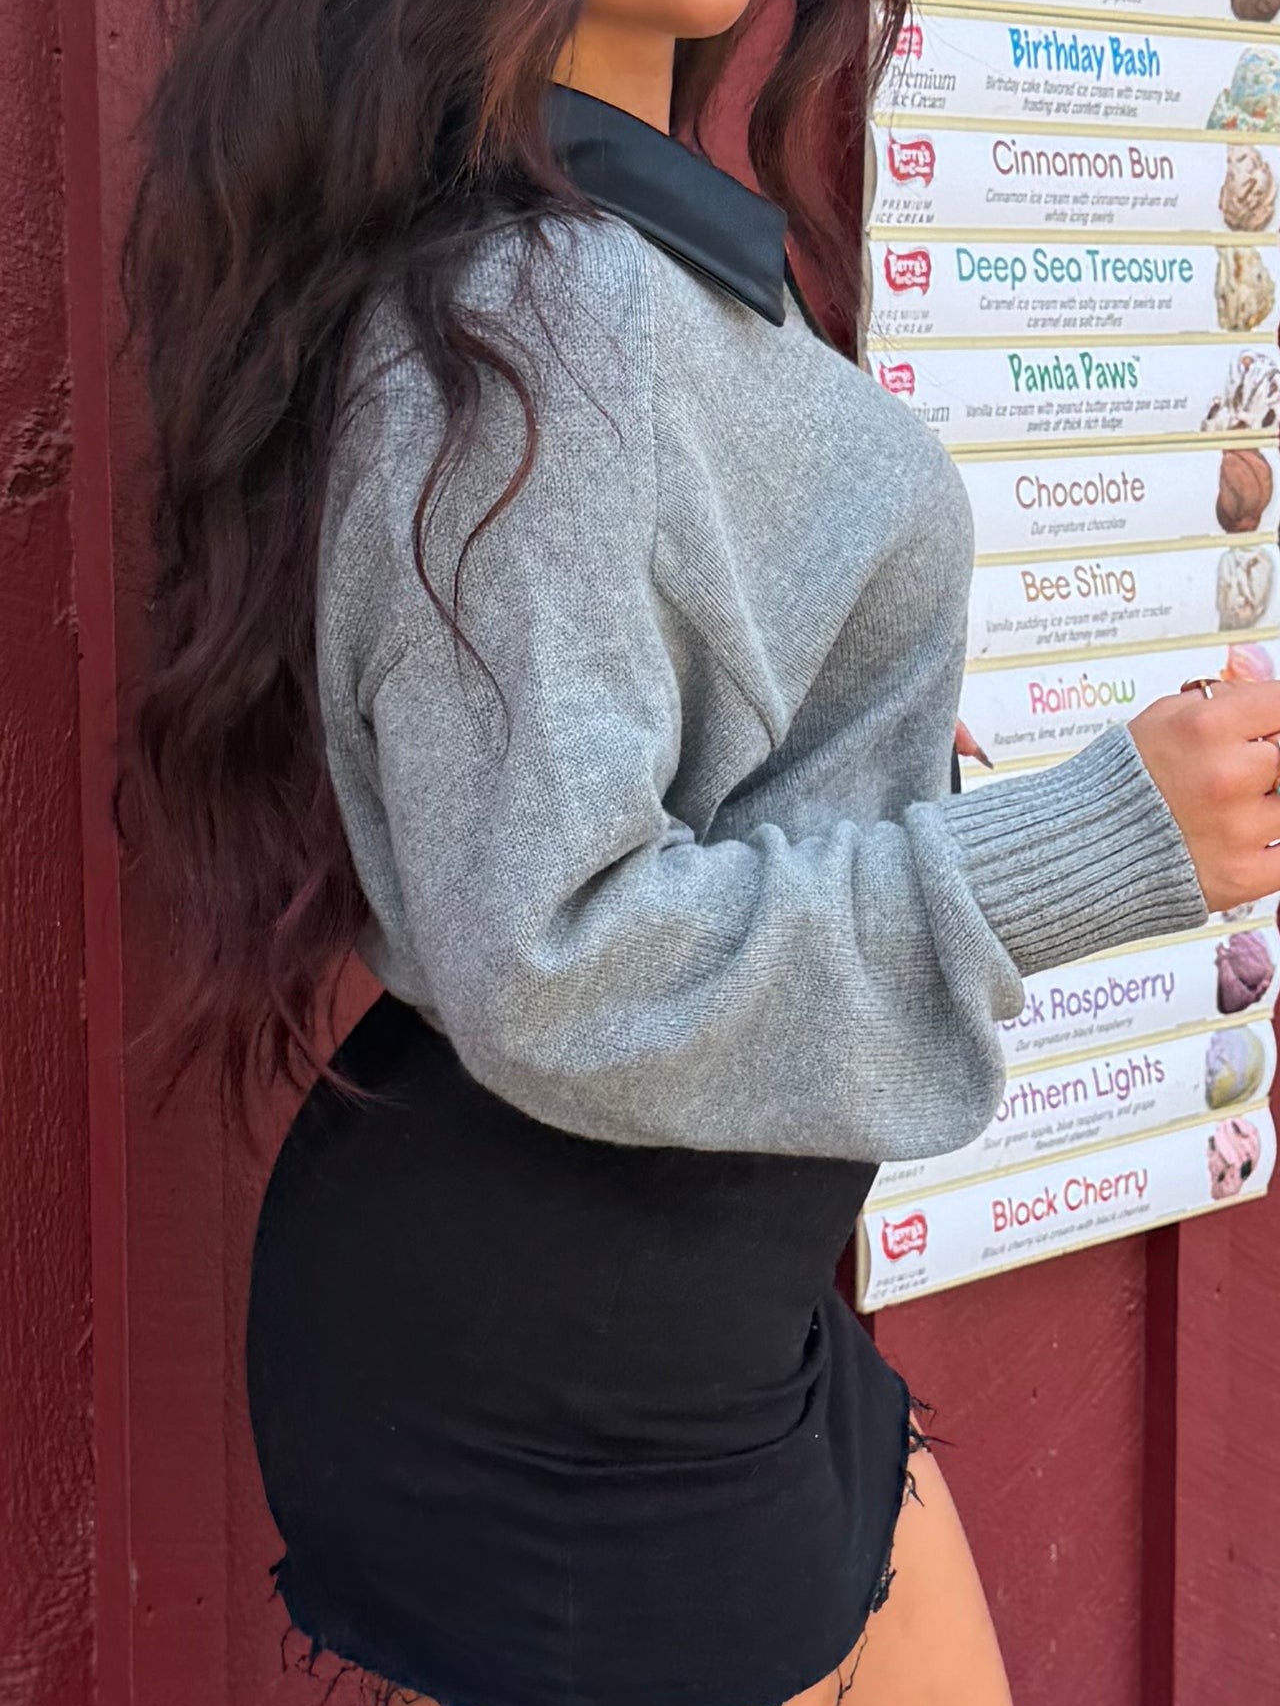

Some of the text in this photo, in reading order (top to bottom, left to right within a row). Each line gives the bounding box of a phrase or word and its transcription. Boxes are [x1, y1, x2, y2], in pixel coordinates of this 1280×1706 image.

[1008, 27, 1160, 81] Birthday Bash
[992, 140, 1173, 180] Cinnamon Bun
[881, 199, 933, 210] PREMIUM
[897, 214, 934, 224] CREAM
[956, 247, 1194, 291] Deep Sea Treasure
[1008, 351, 1138, 393] Panda Paws
[1015, 471, 1145, 509] Chocolate
[1021, 563, 1136, 603] Bee Sting
[1028, 678, 1135, 714] Rainbow
[1050, 972, 1175, 1019] Raspberry
[995, 1054, 1165, 1122] orthern Lights
[992, 1169, 1148, 1233] Black Cherry
